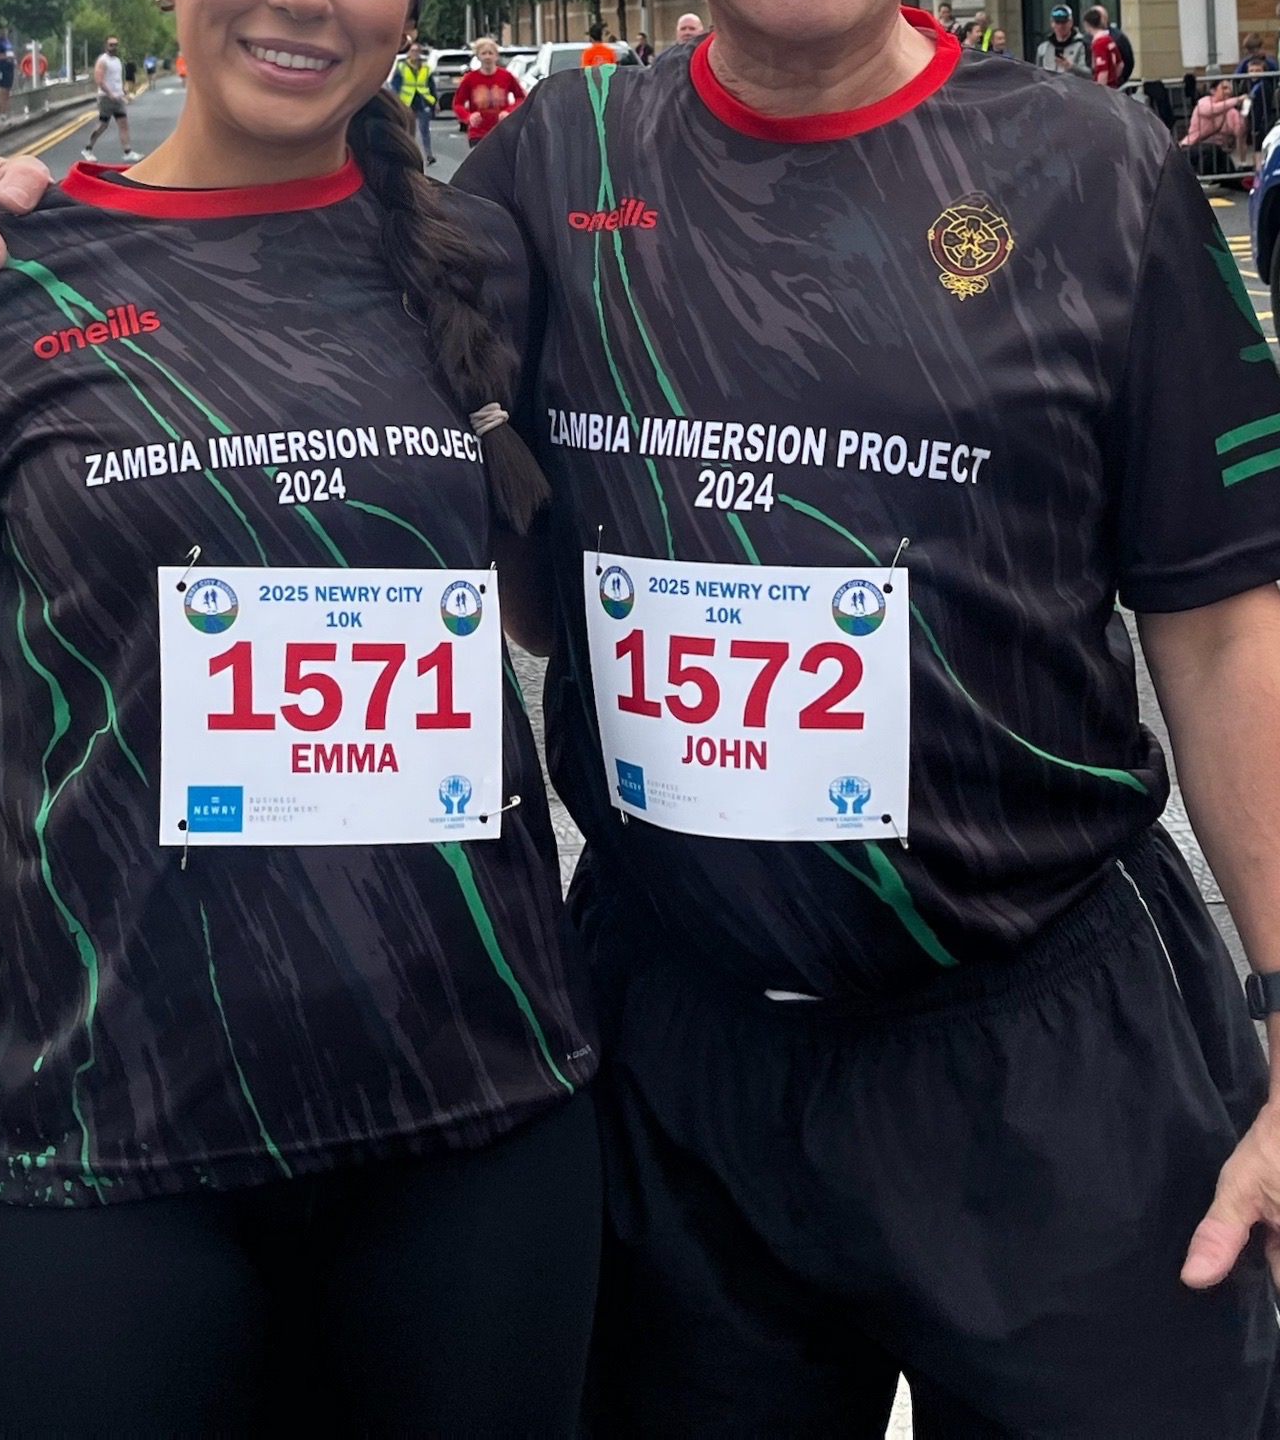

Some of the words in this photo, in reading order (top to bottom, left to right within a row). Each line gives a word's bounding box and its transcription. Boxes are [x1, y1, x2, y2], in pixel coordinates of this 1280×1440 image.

[85, 440, 201, 487] ZAMBIA
[207, 426, 379, 469] IMMERSION
[384, 425, 485, 465] PROJECT
[548, 409, 630, 453] ZAMBIA
[639, 417, 827, 466] IMMERSION
[837, 429, 991, 485] PROJECT
[275, 467, 346, 504] 2024
[694, 468, 774, 513] 2024
[259, 585, 309, 602] 2025
[315, 586, 381, 602] NEWRY
[386, 586, 423, 603] CITY
[649, 577, 690, 595] 2025
[695, 581, 762, 600] NEWRY
[768, 584, 810, 602] CITY
[326, 612, 362, 628] 10K
[705, 607, 742, 624] 10K
[206, 640, 472, 732] 1571
[616, 628, 867, 730] 1572
[290, 743, 400, 774] EMMA
[681, 734, 767, 772] JOHN
[194, 805, 236, 815] NEWRY
